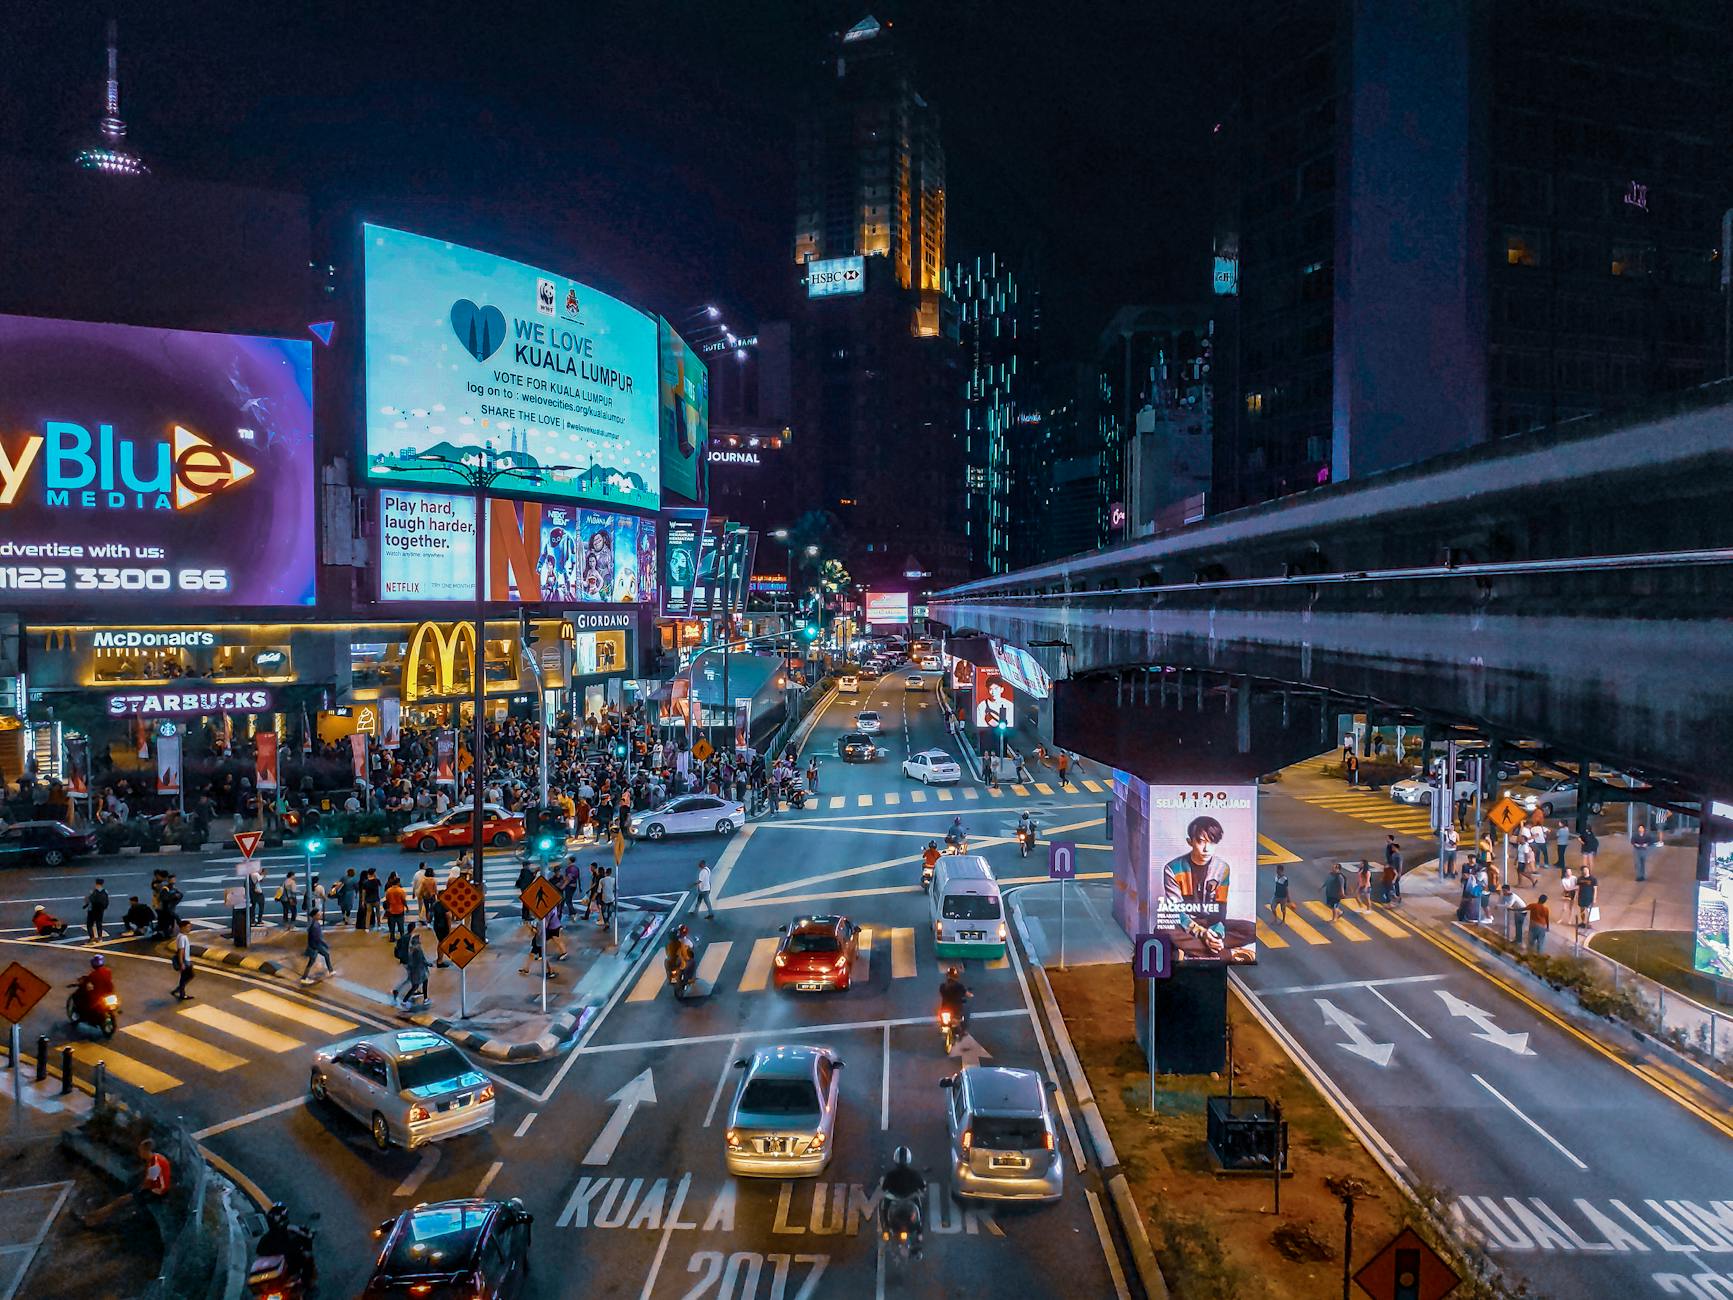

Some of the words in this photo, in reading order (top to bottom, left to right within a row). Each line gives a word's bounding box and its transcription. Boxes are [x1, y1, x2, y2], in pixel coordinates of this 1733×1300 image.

[811, 272, 841, 284] HSBC
[514, 318, 545, 344] WE
[551, 328, 593, 358] LOVE
[515, 343, 577, 377] KUALA
[581, 360, 633, 395] LUMPUR
[467, 381, 484, 397] log
[487, 388, 500, 397] on
[503, 387, 513, 399] to
[494, 370, 523, 386] VOTE
[527, 377, 547, 391] FOR
[550, 383, 580, 400] KUALA
[582, 392, 613, 408] LUMPUR
[481, 404, 516, 419] SHARE
[518, 410, 536, 422] THE
[538, 413, 561, 427] LOVE
[707, 452, 760, 463] JOURNAL
[47, 490, 171, 509] MEDIA
[384, 497, 416, 515] Play
[420, 499, 456, 518] hard,
[385, 516, 426, 534] laugh
[429, 518, 476, 536] harder,
[0, 541, 84, 557] dvertise
[88, 544, 131, 558] with
[135, 547, 165, 559] us:
[385, 532, 450, 550] together.
[75, 569, 171, 590] 3300
[178, 569, 227, 590] 66
[385, 582, 420, 593] NETFLIX
[577, 614, 629, 628] GIORDANO
[93, 631, 214, 647] McDonald's
[110, 691, 267, 713] STARBUCKS
[1157, 903, 1200, 912] JACKSON
[1202, 904, 1219, 912] YEE
[555, 1171, 737, 1233] KUALA
[1447, 1195, 1652, 1251] UALA
[681, 1251, 831, 1300] 2017
